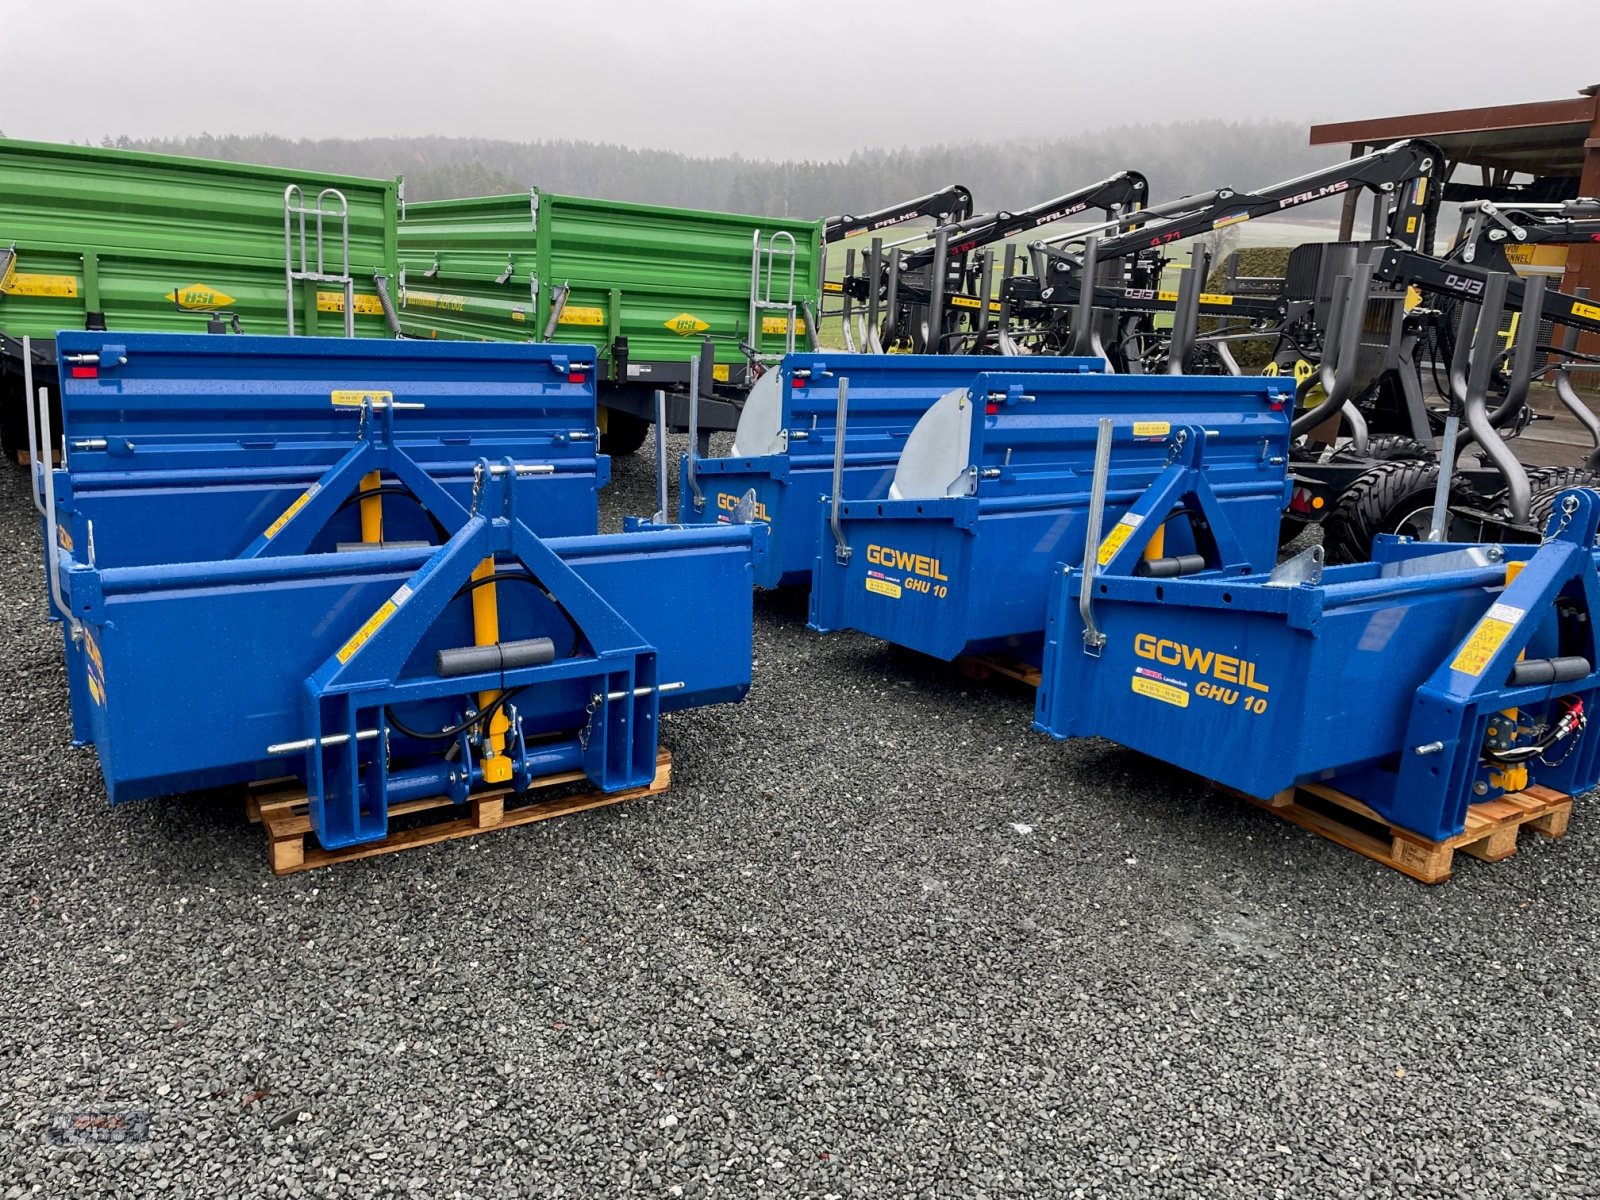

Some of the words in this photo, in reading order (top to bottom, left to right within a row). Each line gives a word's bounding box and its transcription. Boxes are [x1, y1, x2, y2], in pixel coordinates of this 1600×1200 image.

[1279, 180, 1350, 209] PALMS
[874, 211, 919, 229] PALMS
[1036, 201, 1087, 226] PALMS
[905, 577, 931, 593] GHU
[933, 585, 948, 598] 10
[1195, 682, 1239, 705] GHU
[1244, 695, 1268, 715] 10
